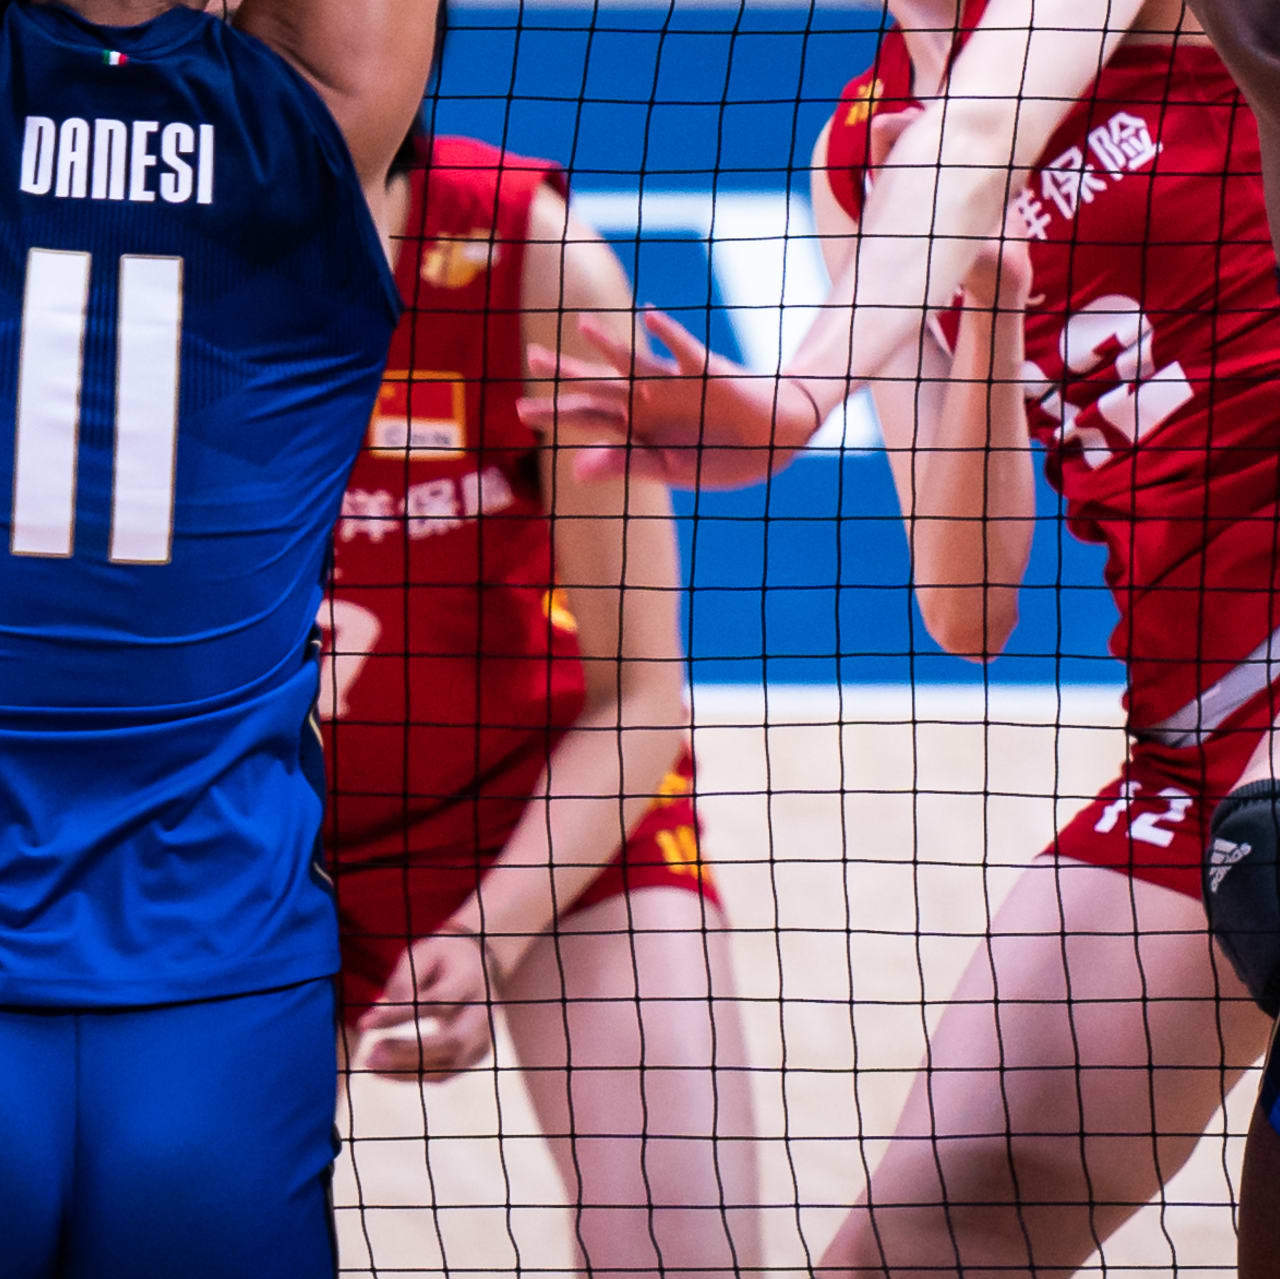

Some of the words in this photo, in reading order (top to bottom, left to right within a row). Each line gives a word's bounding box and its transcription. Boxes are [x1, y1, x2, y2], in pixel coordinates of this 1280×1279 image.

[20, 116, 214, 204] DANESI
[10, 247, 183, 565] 11
[1094, 781, 1193, 847] 12
